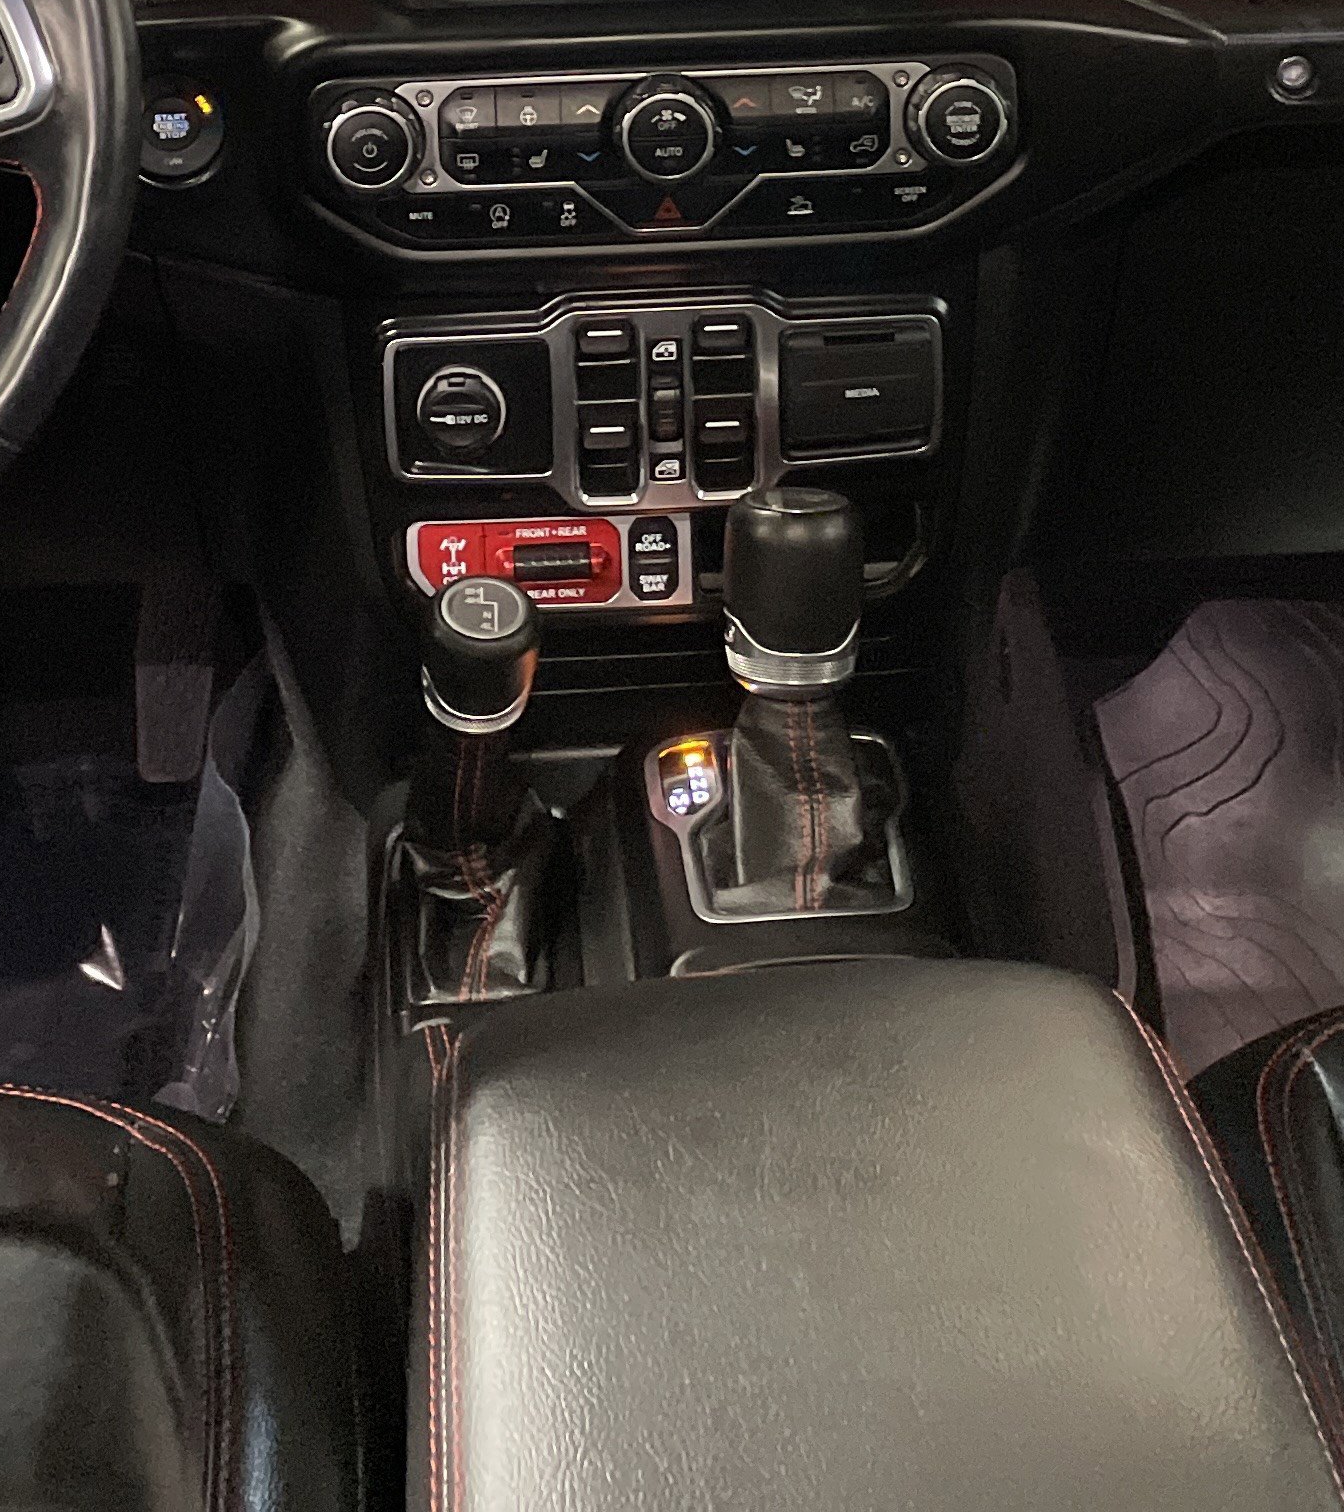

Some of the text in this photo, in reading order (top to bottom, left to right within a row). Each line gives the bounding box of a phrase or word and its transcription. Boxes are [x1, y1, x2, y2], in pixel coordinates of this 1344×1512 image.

[850, 95, 875, 109] A/C
[154, 113, 187, 122] START
[654, 146, 683, 157] AUTO
[409, 211, 434, 221] MUTE
[457, 413, 488, 425] 12V DC
[641, 534, 663, 543] OFF
[639, 574, 669, 585] SWAY
[557, 588, 586, 599] ONLY
[642, 583, 666, 593] BAR
[690, 777, 708, 790] N
[668, 793, 690, 807] M
[691, 790, 710, 804] D
